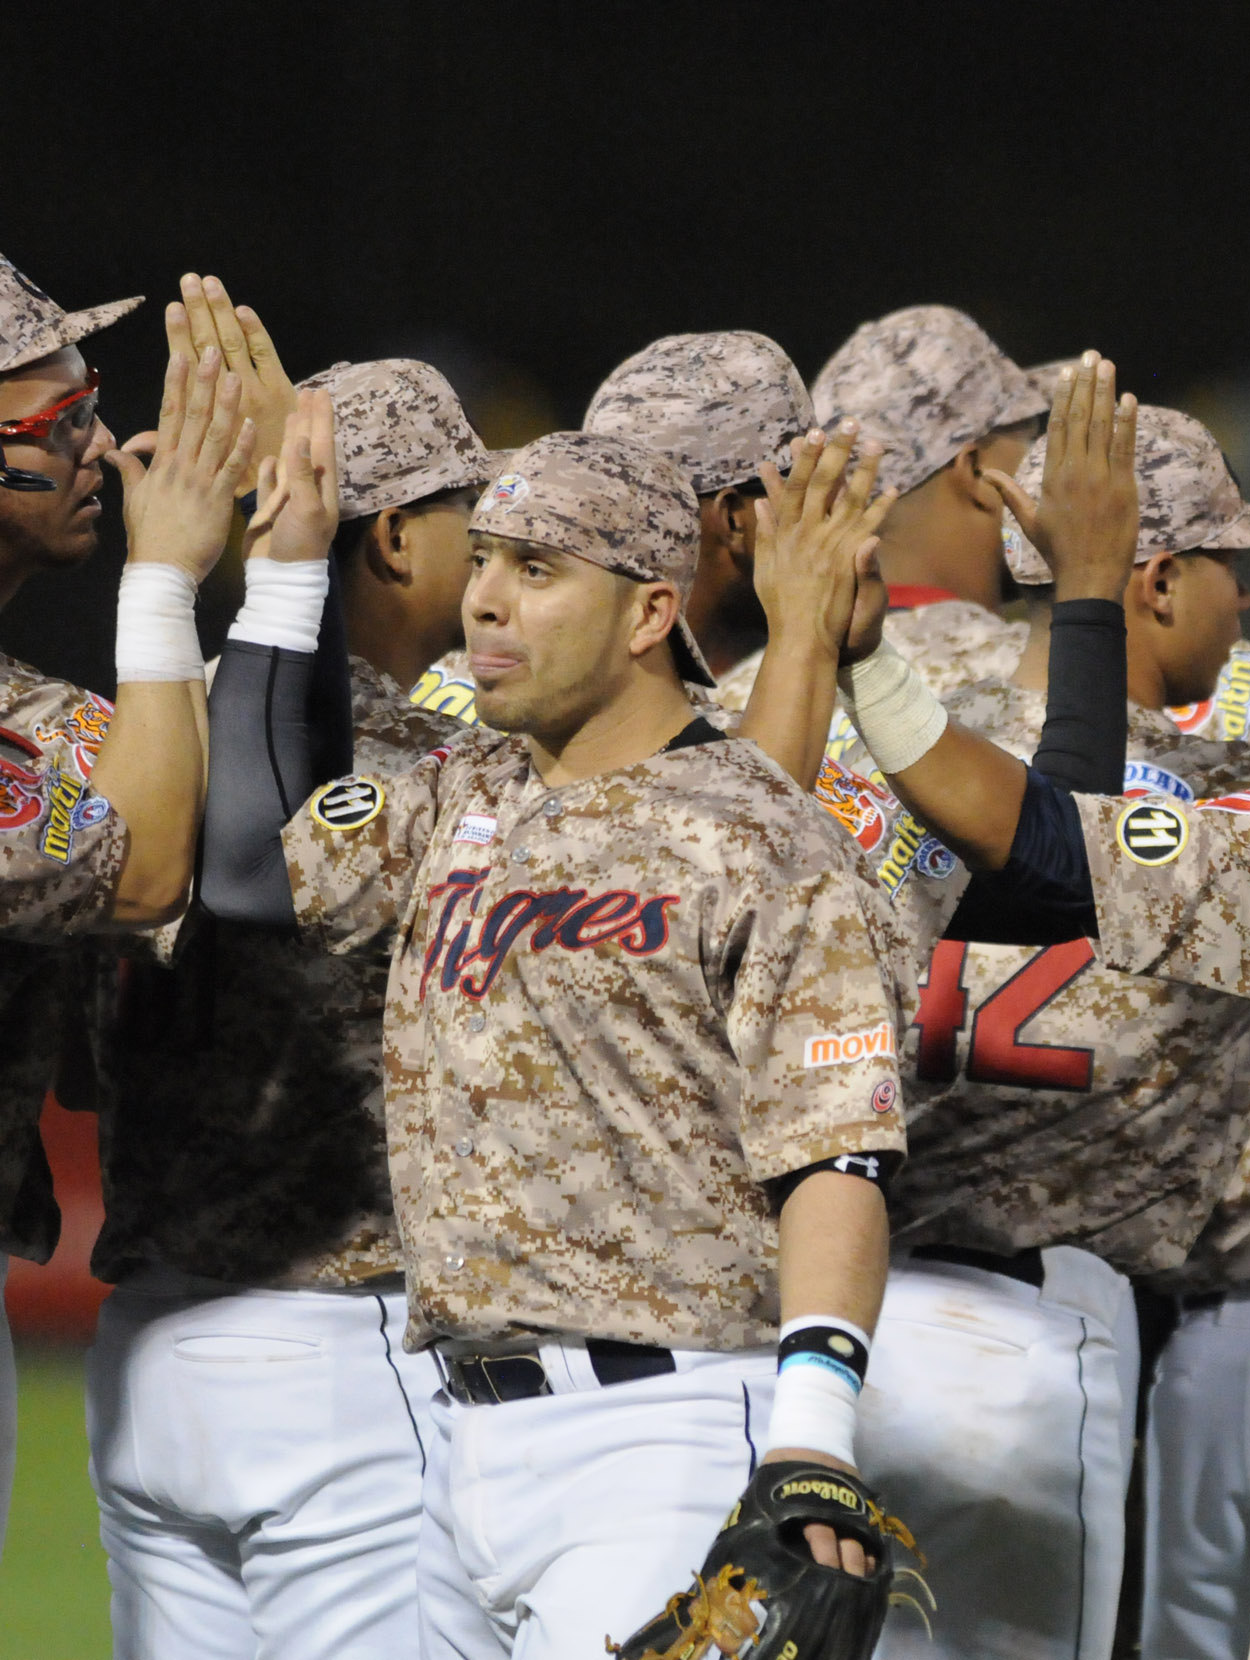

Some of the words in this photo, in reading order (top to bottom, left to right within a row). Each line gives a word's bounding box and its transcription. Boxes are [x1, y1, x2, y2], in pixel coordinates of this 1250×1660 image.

[1125, 764, 1191, 801] OLAR
[323, 785, 374, 819] 11
[1128, 811, 1179, 847] 11
[419, 866, 681, 1002] Tigres
